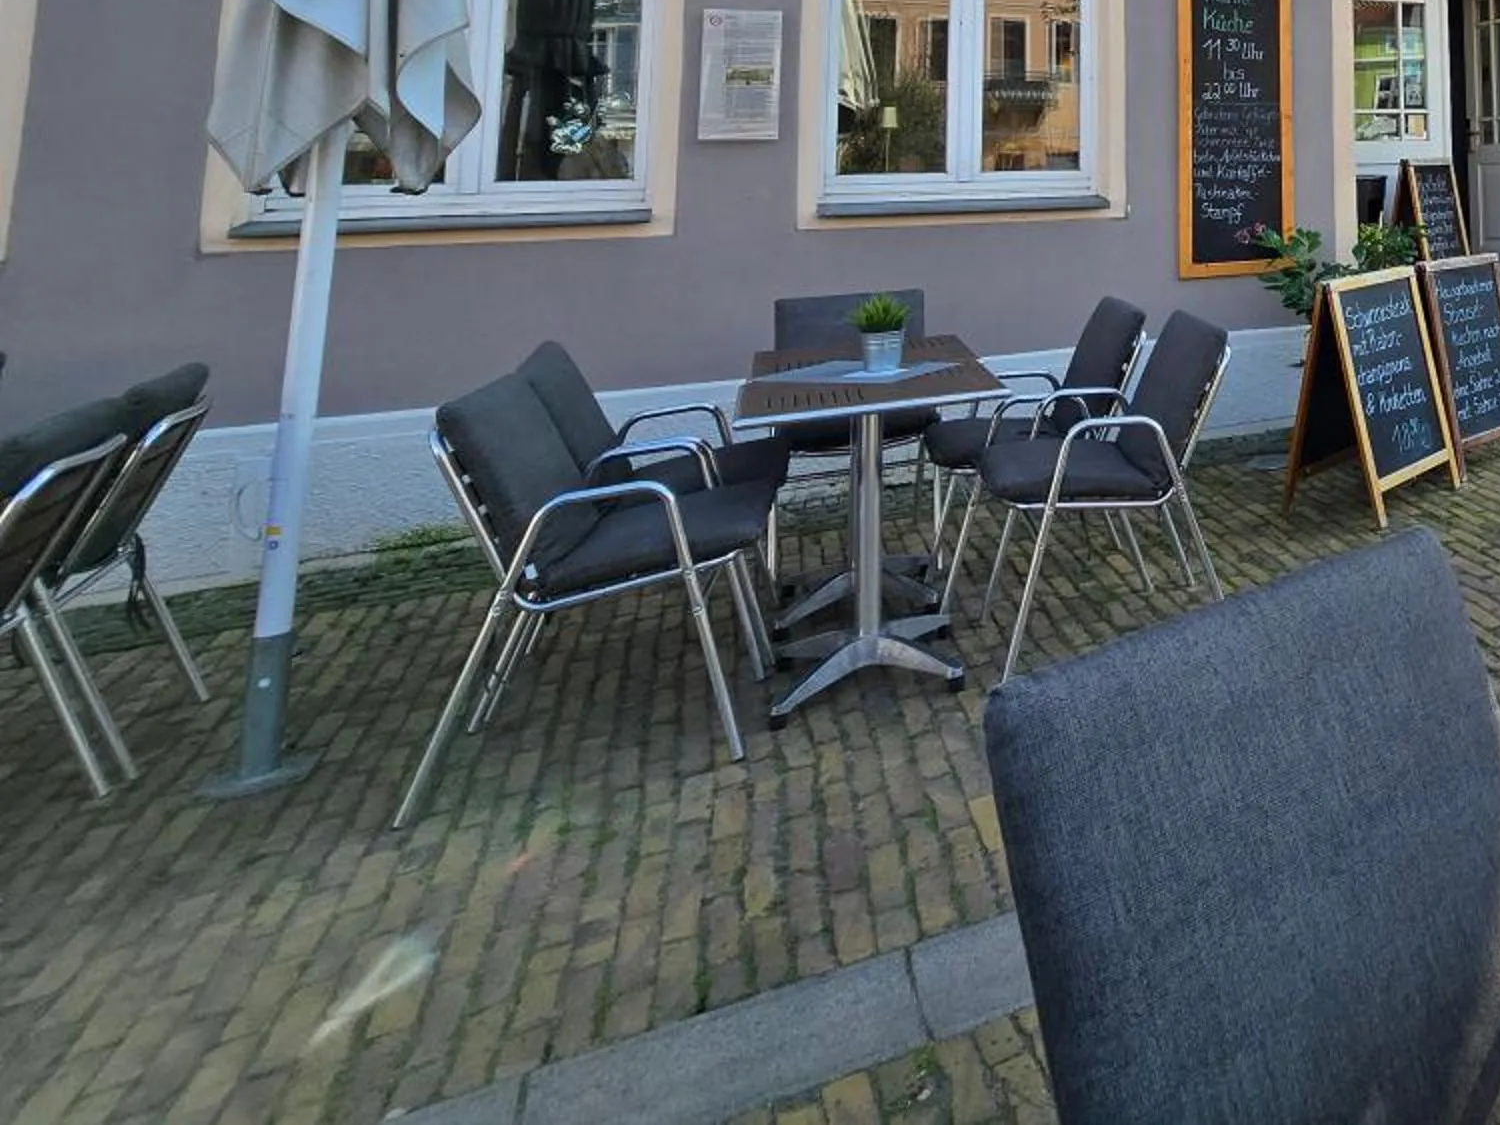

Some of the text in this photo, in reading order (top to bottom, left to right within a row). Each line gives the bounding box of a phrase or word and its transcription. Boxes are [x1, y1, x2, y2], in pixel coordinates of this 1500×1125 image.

[1203, 7, 1254, 34] Küche
[1241, 42, 1263, 59] Uhr
[1223, 61, 1245, 80] bis
[1239, 82, 1260, 98] Uhr
[1200, 202, 1245, 225] Stampf
